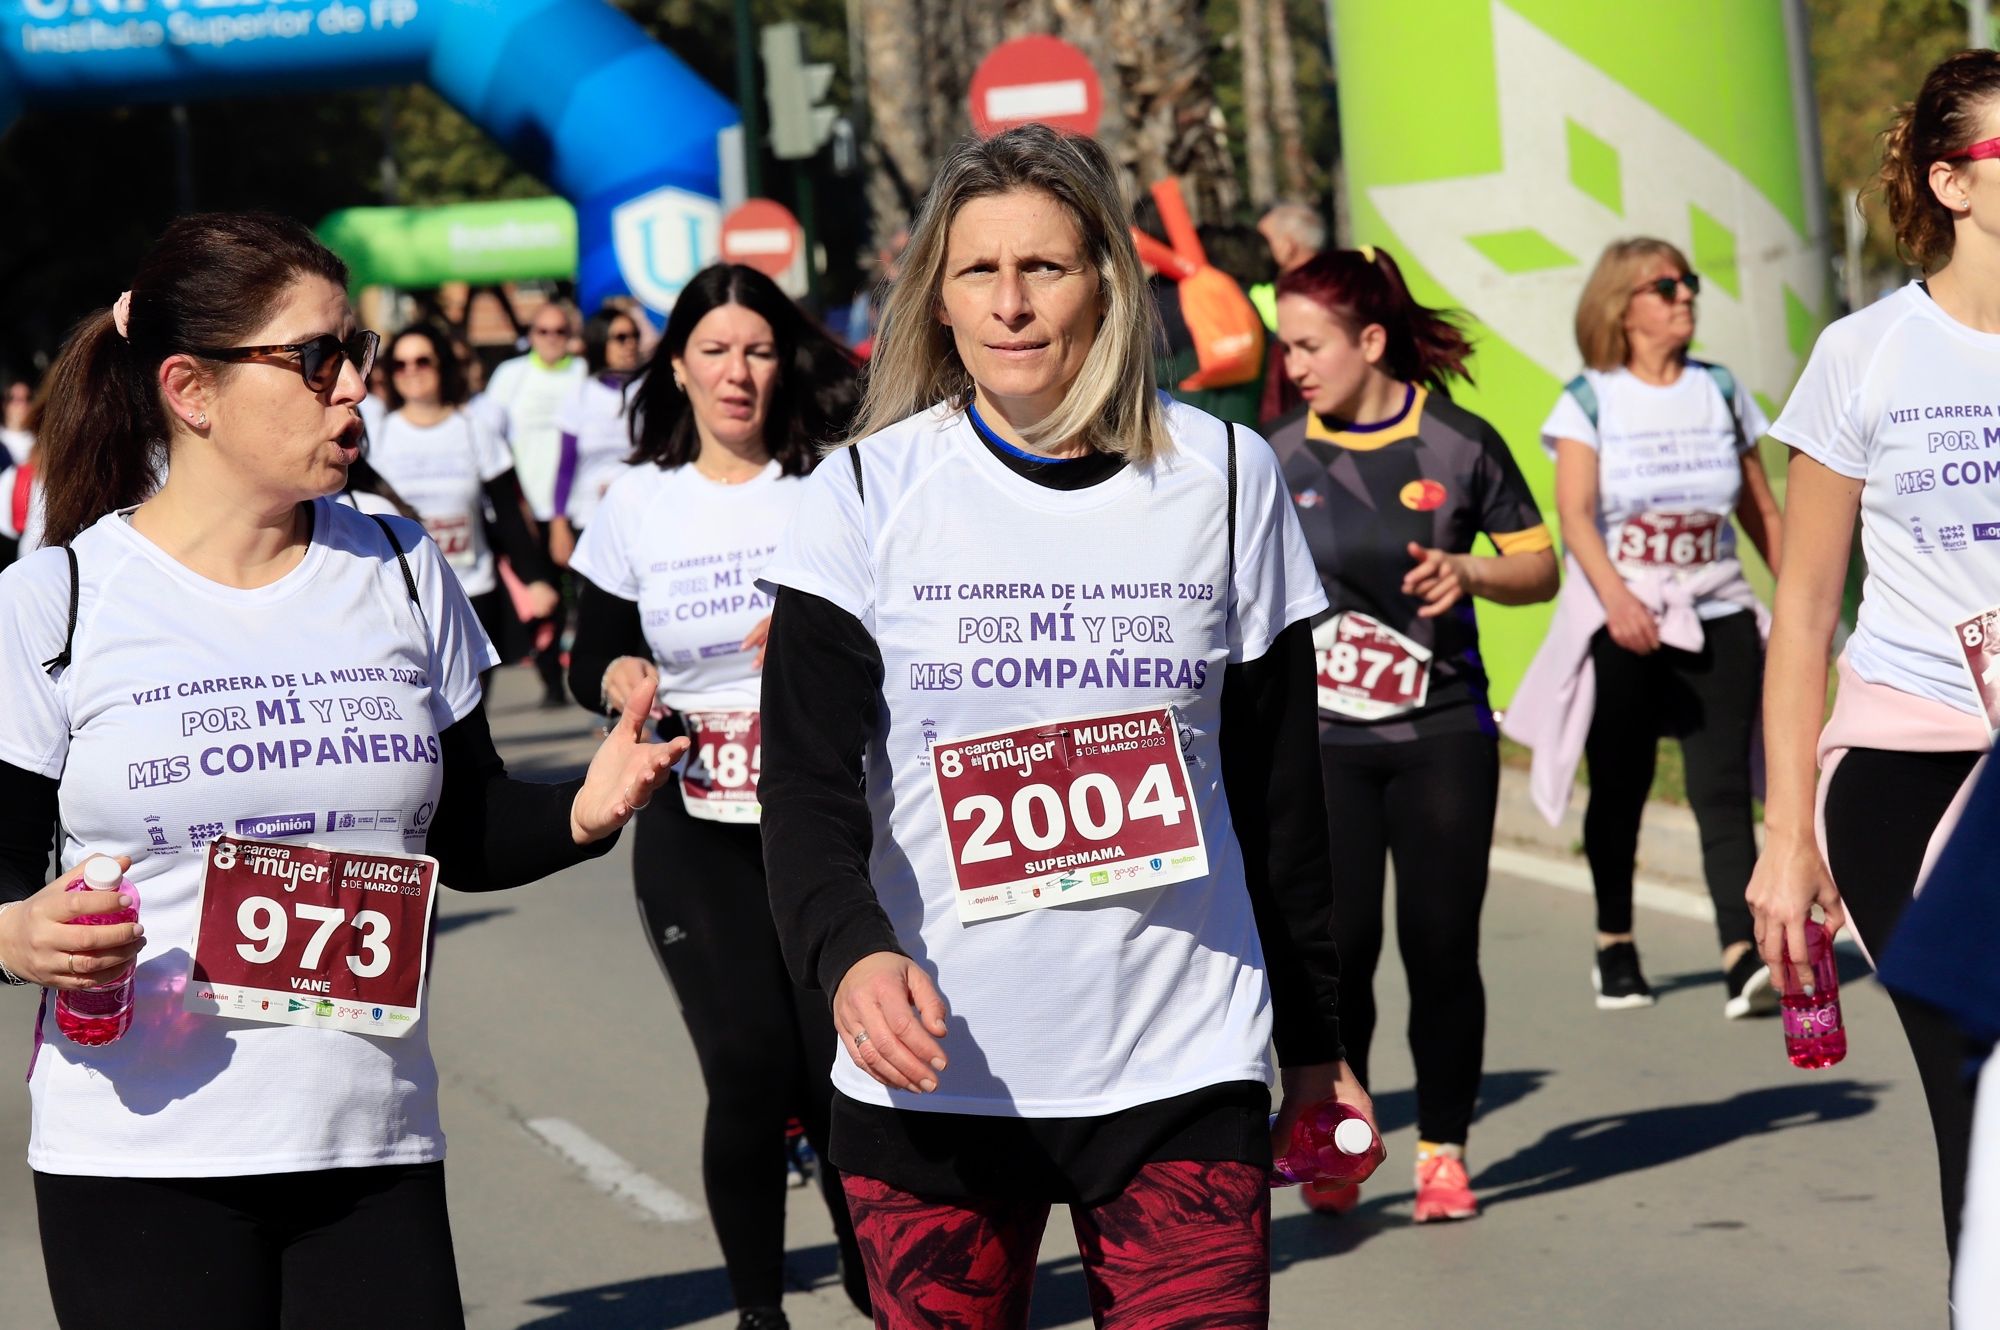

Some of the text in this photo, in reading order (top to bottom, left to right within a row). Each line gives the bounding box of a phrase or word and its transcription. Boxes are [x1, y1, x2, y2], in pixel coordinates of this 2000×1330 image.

[166, 10, 313, 46] Superior
[317, 2, 366, 34] de
[1889, 408, 1920, 424] VIII
[1924, 405, 1993, 420] CARRERA
[1927, 430, 1980, 453] POR
[1895, 468, 1936, 495] MIS
[1621, 524, 1714, 566] 3161
[913, 583, 1214, 601] VIII CARRERA DE LA MUJER 2023
[959, 602, 1174, 644] POR MÍ Y POR
[910, 648, 1208, 690] MIS COMPAÑERAS
[132, 685, 171, 706] VIII
[177, 675, 267, 697] CARRERA
[271, 673, 297, 688] DE
[301, 671, 327, 686] LA
[330, 667, 388, 684] MUJER
[182, 690, 403, 737] POR MÍ Y POR
[1073, 718, 1163, 746] MURCIA
[1076, 736, 1166, 757] 5 DE MARZO 2023
[128, 727, 439, 790] MIS COMPAÑERAS
[964, 738, 1014, 756] carrera
[982, 740, 1056, 778] mujer
[240, 817, 312, 836] LaOpinión
[952, 763, 1187, 865] 2004
[243, 844, 291, 860] carrera
[1024, 845, 1126, 875] SUPERMAMA
[253, 856, 329, 893] mujer
[343, 860, 421, 885] MURCIA
[350, 881, 362, 890] DE
[364, 882, 398, 893] MARZO
[400, 886, 421, 897] 2023
[235, 895, 392, 979] 973
[290, 976, 331, 993] VANE
